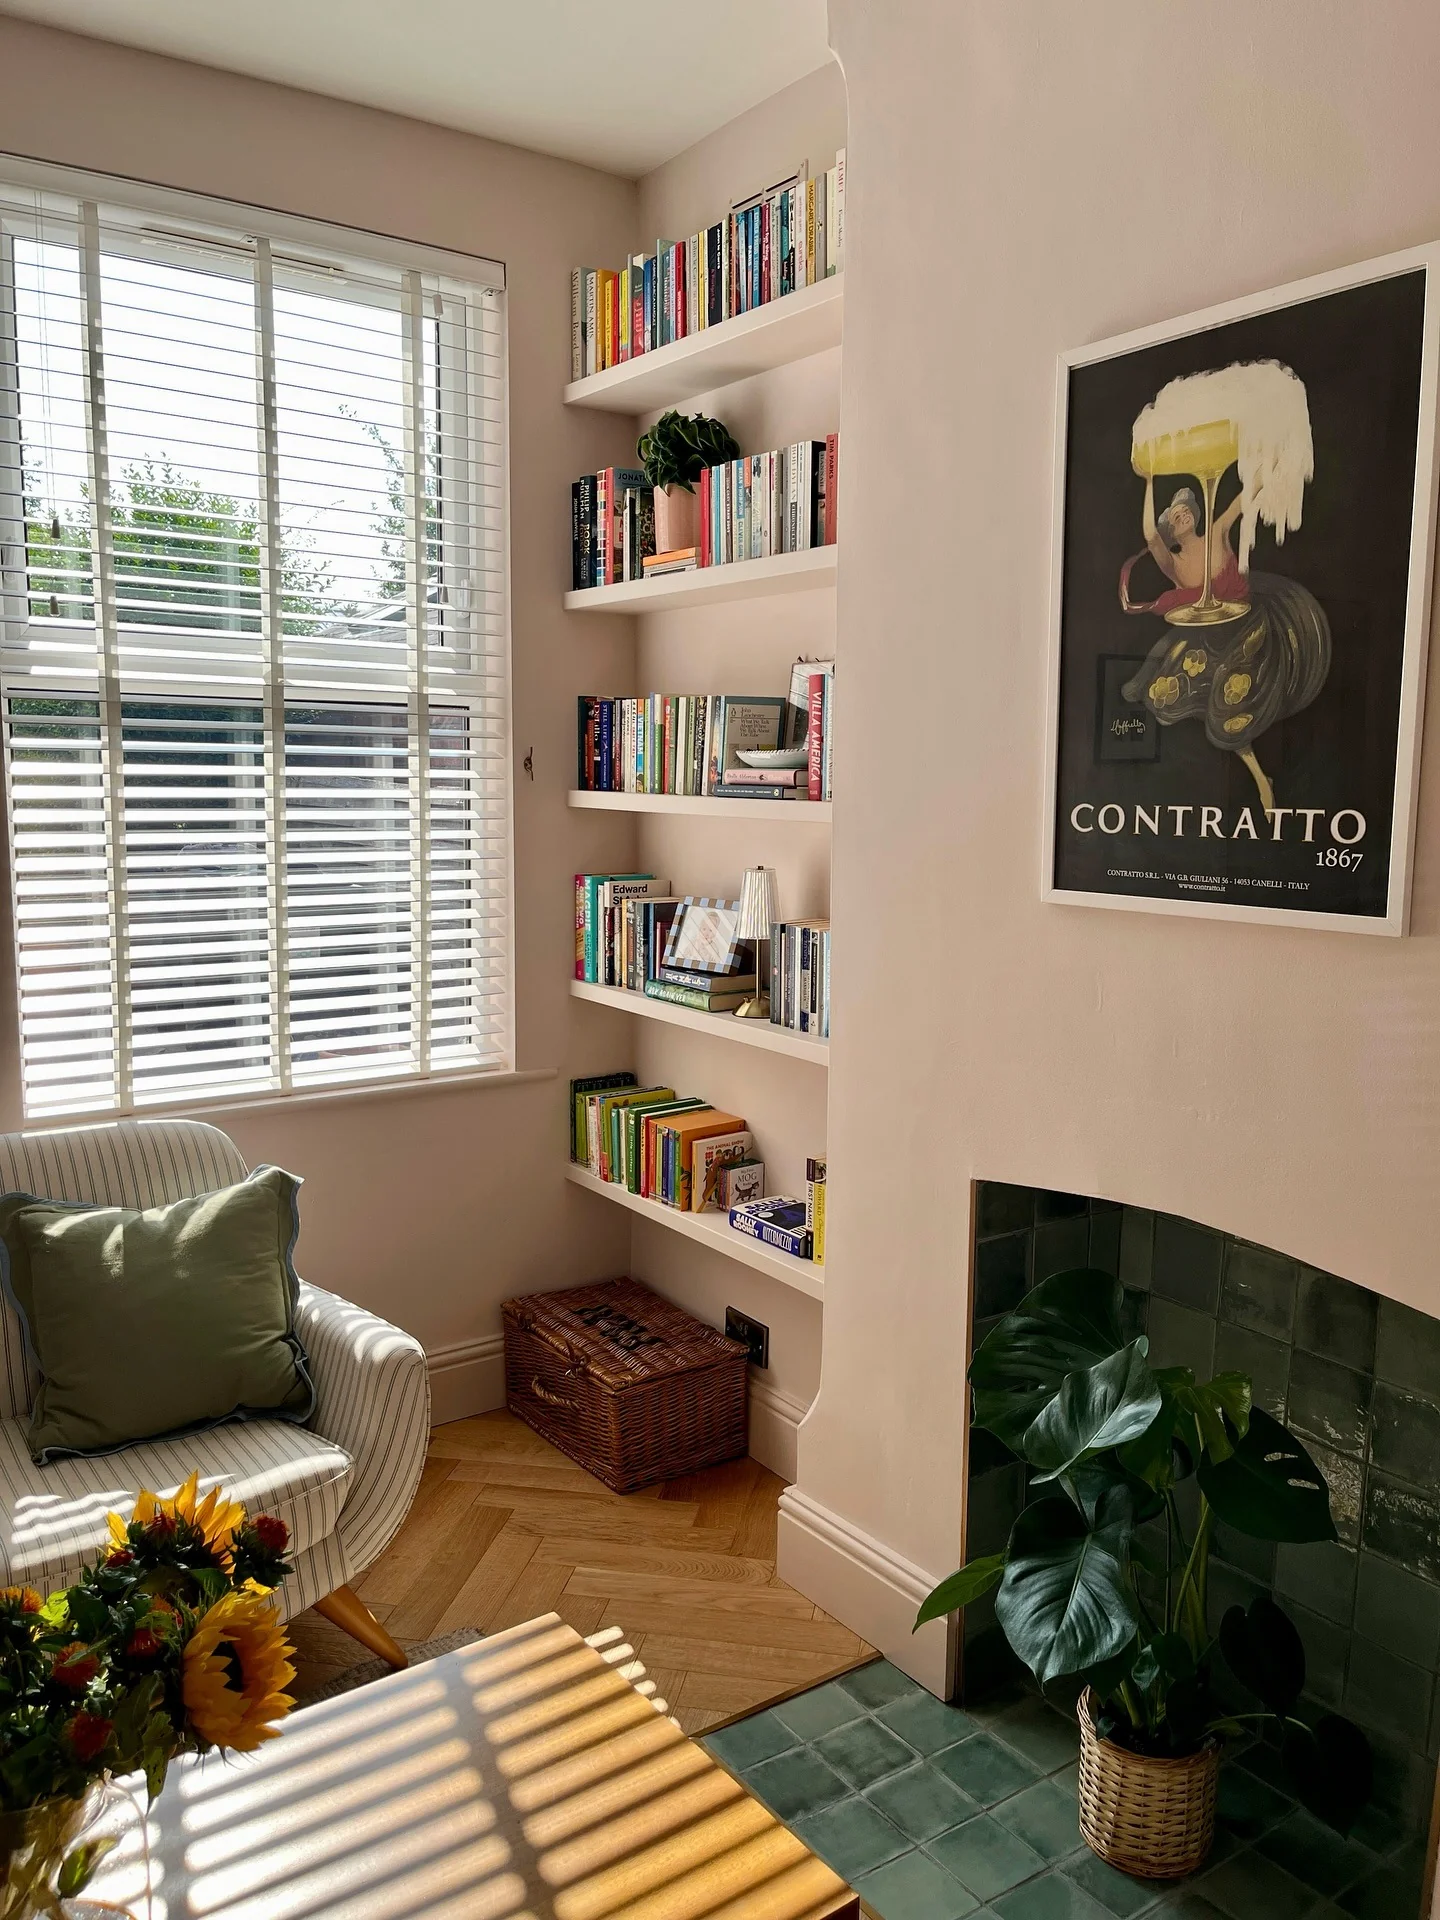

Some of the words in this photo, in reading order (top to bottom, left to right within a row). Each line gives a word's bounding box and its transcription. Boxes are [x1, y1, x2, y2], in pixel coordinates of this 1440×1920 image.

[572, 321, 580, 350] Boyd
[811, 691, 822, 726] VILLA
[810, 730, 821, 782] AMERICA
[1069, 802, 1367, 845] CONTRATTO
[1315, 847, 1363, 873] 1867
[612, 883, 648, 894] Edward
[1107, 868, 1145, 878] CONTRATTO
[1144, 871, 1160, 880] S.R.L.
[1165, 873, 1176, 881] VIA
[1189, 874, 1221, 884] GIULIANI
[1221, 877, 1229, 885] 56
[1233, 878, 1251, 886] 14053
[1251, 879, 1283, 889] CANELLI
[1287, 881, 1311, 890] ITALY
[1178, 882, 1226, 892] www.contratto.it
[715, 1142, 731, 1150] ANIMAL
[731, 1139, 744, 1147] SHOW
[737, 1171, 757, 1183] MOG
[732, 1219, 760, 1238] ROONEY
[735, 1213, 757, 1229] SALLY
[762, 1225, 793, 1252] INTERMEZZO
